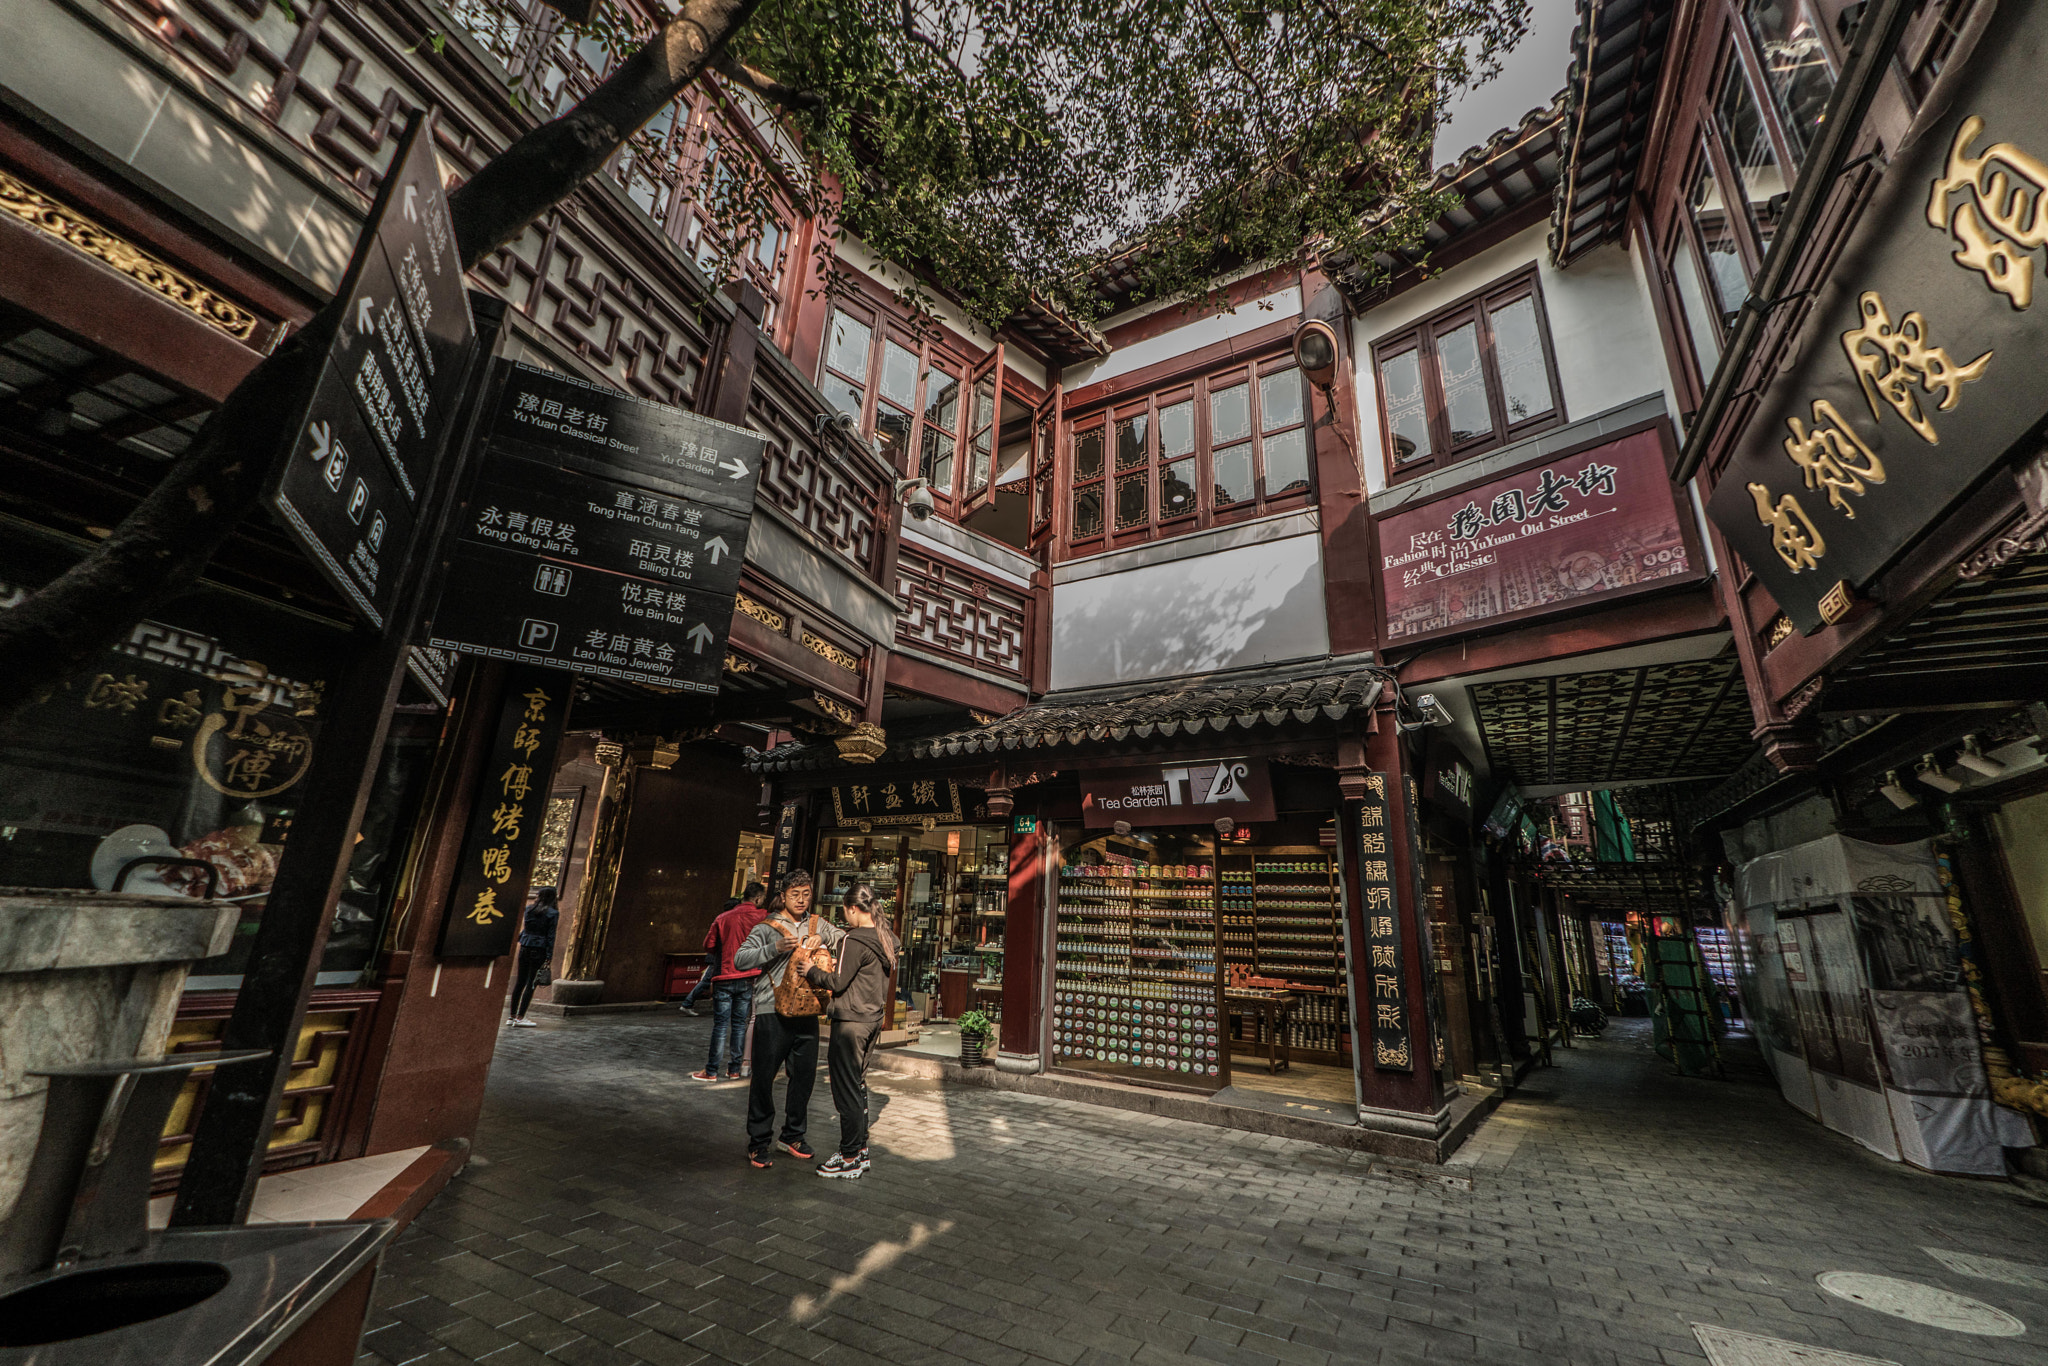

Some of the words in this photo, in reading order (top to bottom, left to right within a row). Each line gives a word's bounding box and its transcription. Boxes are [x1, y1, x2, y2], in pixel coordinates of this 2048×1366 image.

[383, 297, 430, 416] 上海五香豆商店
[361, 350, 403, 442] 南翔馒头店
[517, 392, 608, 432] 豫园老街
[512, 410, 528, 424] Yu
[530, 413, 558, 431] Yuan
[559, 423, 607, 446] Classical
[608, 437, 639, 455] Street
[660, 452, 675, 465] Yu
[676, 457, 715, 477] Garden
[679, 441, 719, 465] 豫园
[480, 505, 577, 543] 永青假发
[587, 502, 615, 520] Tong
[617, 508, 641, 525] Han
[642, 513, 672, 531] Chun
[673, 521, 700, 540] Tang
[614, 490, 704, 527] 童涵春堂
[476, 523, 508, 542] Yong
[511, 530, 540, 550] Qing
[542, 537, 561, 554] Jia
[562, 542, 579, 556] Fa
[1384, 547, 1429, 569] Fashion
[1431, 543, 1470, 564] 时尚
[1470, 530, 1516, 554] YuYuan
[1521, 521, 1544, 536] Old
[1549, 507, 1590, 530] Street
[1409, 530, 1443, 552] 尽在
[638, 560, 668, 577] Biling
[670, 566, 692, 580] Lou
[1402, 561, 1437, 588] 经典
[1434, 552, 1494, 578] Classic
[621, 582, 687, 612] 悦宾楼
[622, 603, 644, 617] Yue
[646, 608, 664, 621] Bin
[572, 647, 597, 662] Lao
[598, 651, 627, 668] Miao
[629, 655, 674, 676] Jewelry
[585, 629, 676, 662] 老庙黄金
[1098, 797, 1121, 810] Tea
[1122, 796, 1165, 808] Garden
[1019, 817, 1031, 827] 64
